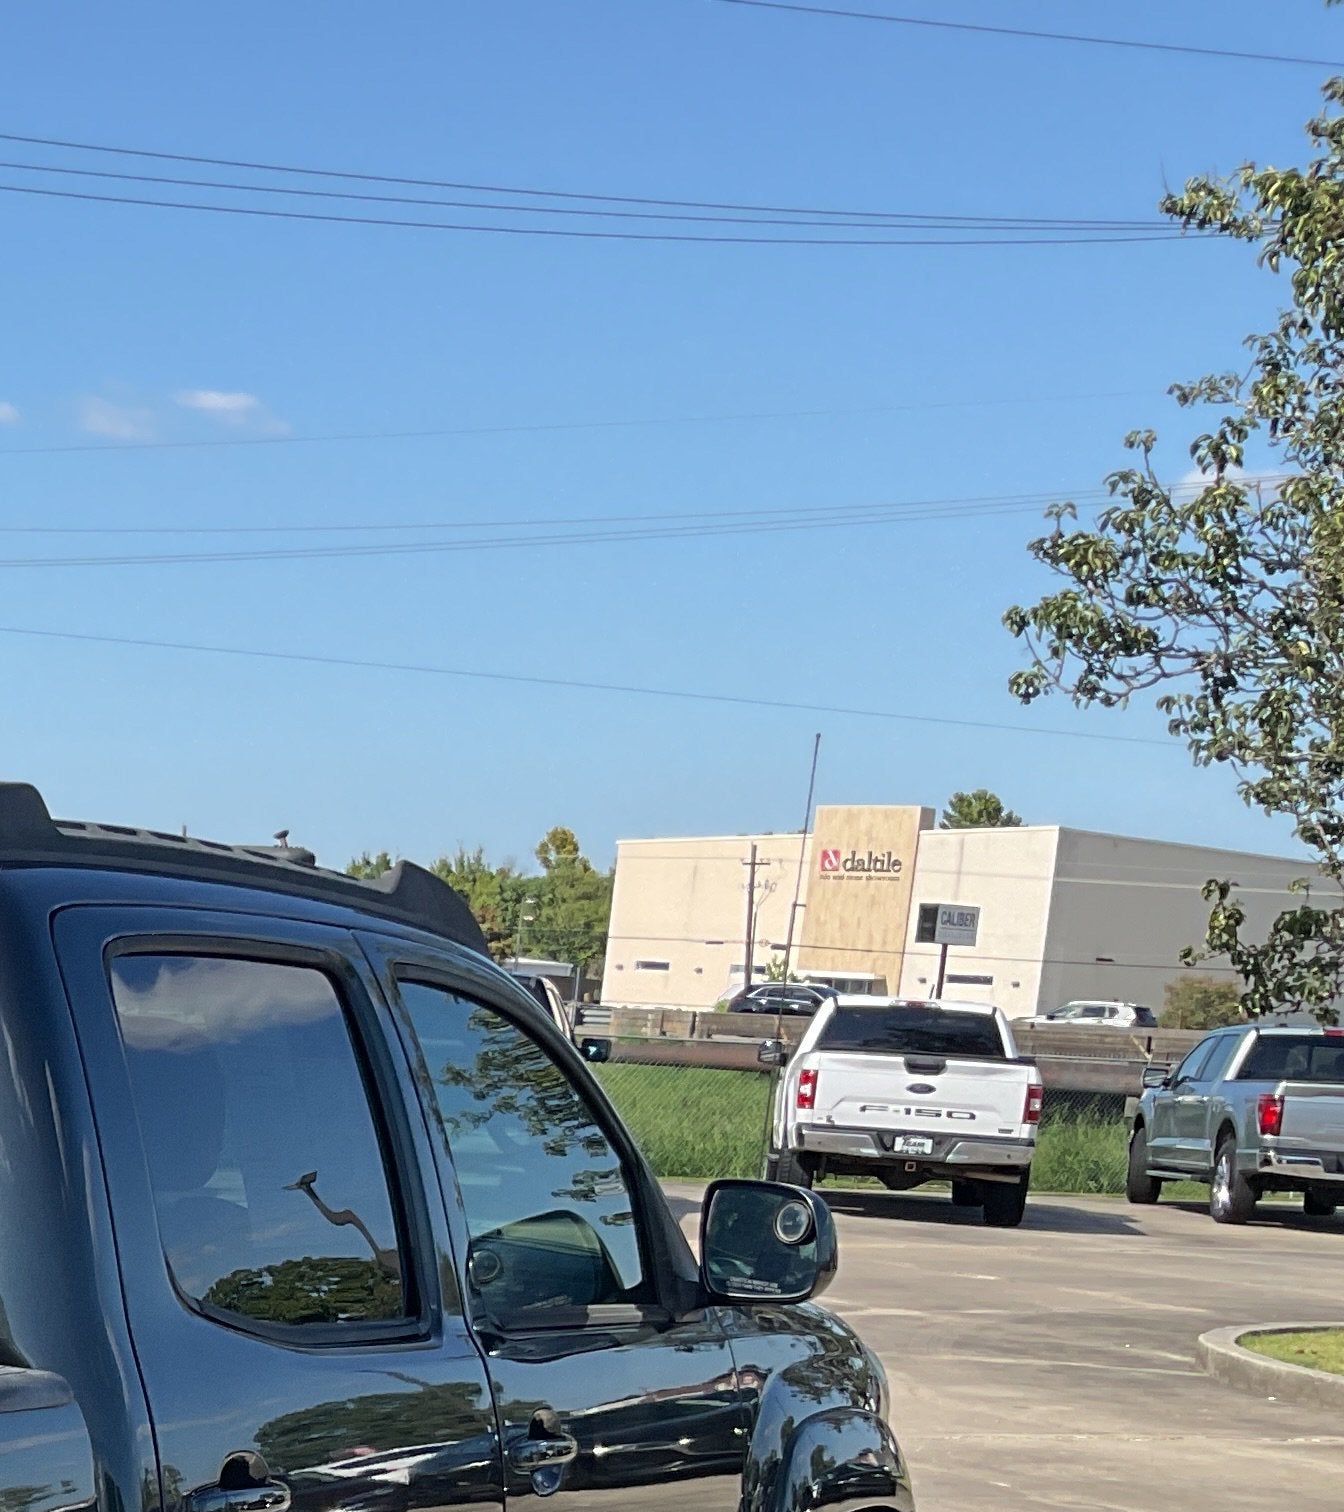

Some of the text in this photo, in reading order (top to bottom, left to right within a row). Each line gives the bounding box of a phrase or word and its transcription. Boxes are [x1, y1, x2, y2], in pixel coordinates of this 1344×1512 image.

[842, 850, 902, 873] daltile
[940, 910, 976, 928] CALIBER
[859, 1104, 976, 1121] F-150
